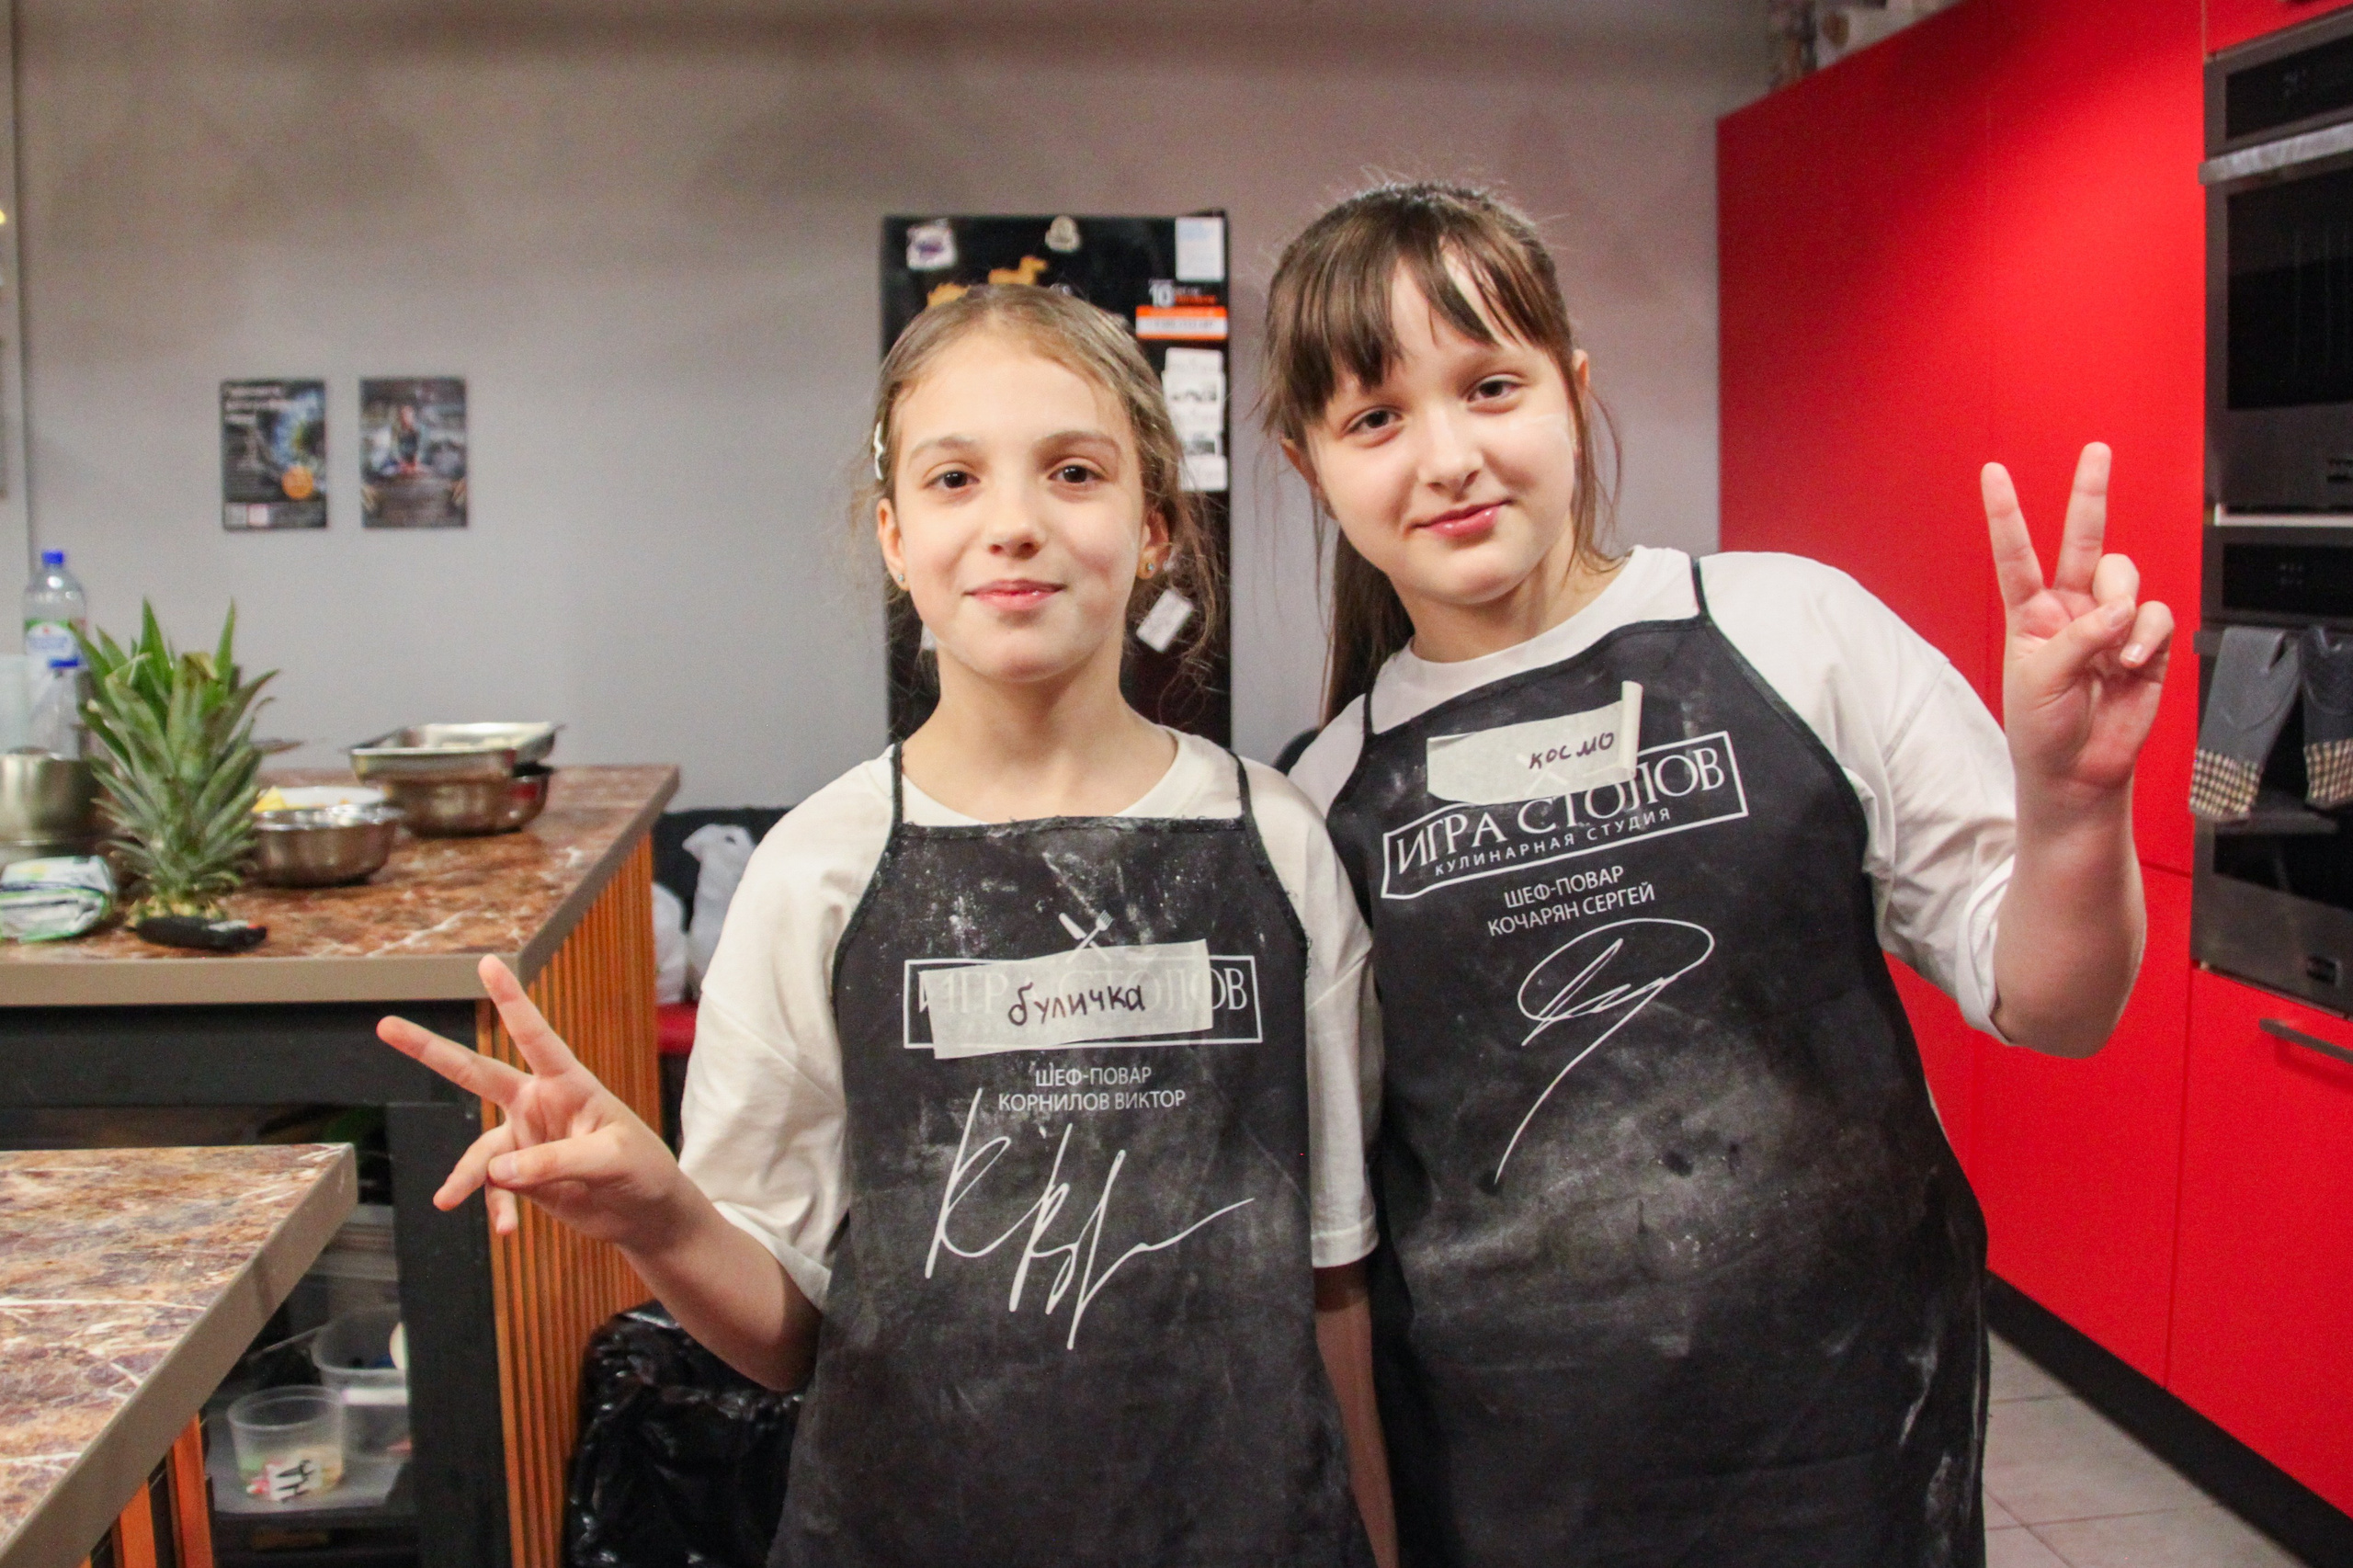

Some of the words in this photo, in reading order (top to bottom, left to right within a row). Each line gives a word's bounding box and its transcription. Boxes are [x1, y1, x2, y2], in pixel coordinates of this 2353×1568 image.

[1396, 812, 1507, 874] ИГРА
[1435, 834, 1575, 876] КУЛИНАРНАЯ
[1586, 807, 1671, 841] СТУДИЯ
[1504, 865, 1624, 908] ШЕФ-ПОВАР
[1487, 902, 1580, 937] КОЧАРЯН
[1583, 883, 1655, 915] СЕРГЕЙ
[1007, 982, 1146, 1026] буличка
[1035, 1066, 1153, 1087] ШЕФ-ПОВАР
[998, 1091, 1110, 1112] КОРНИЛОВ
[1114, 1090, 1187, 1110] ВИКТОР
